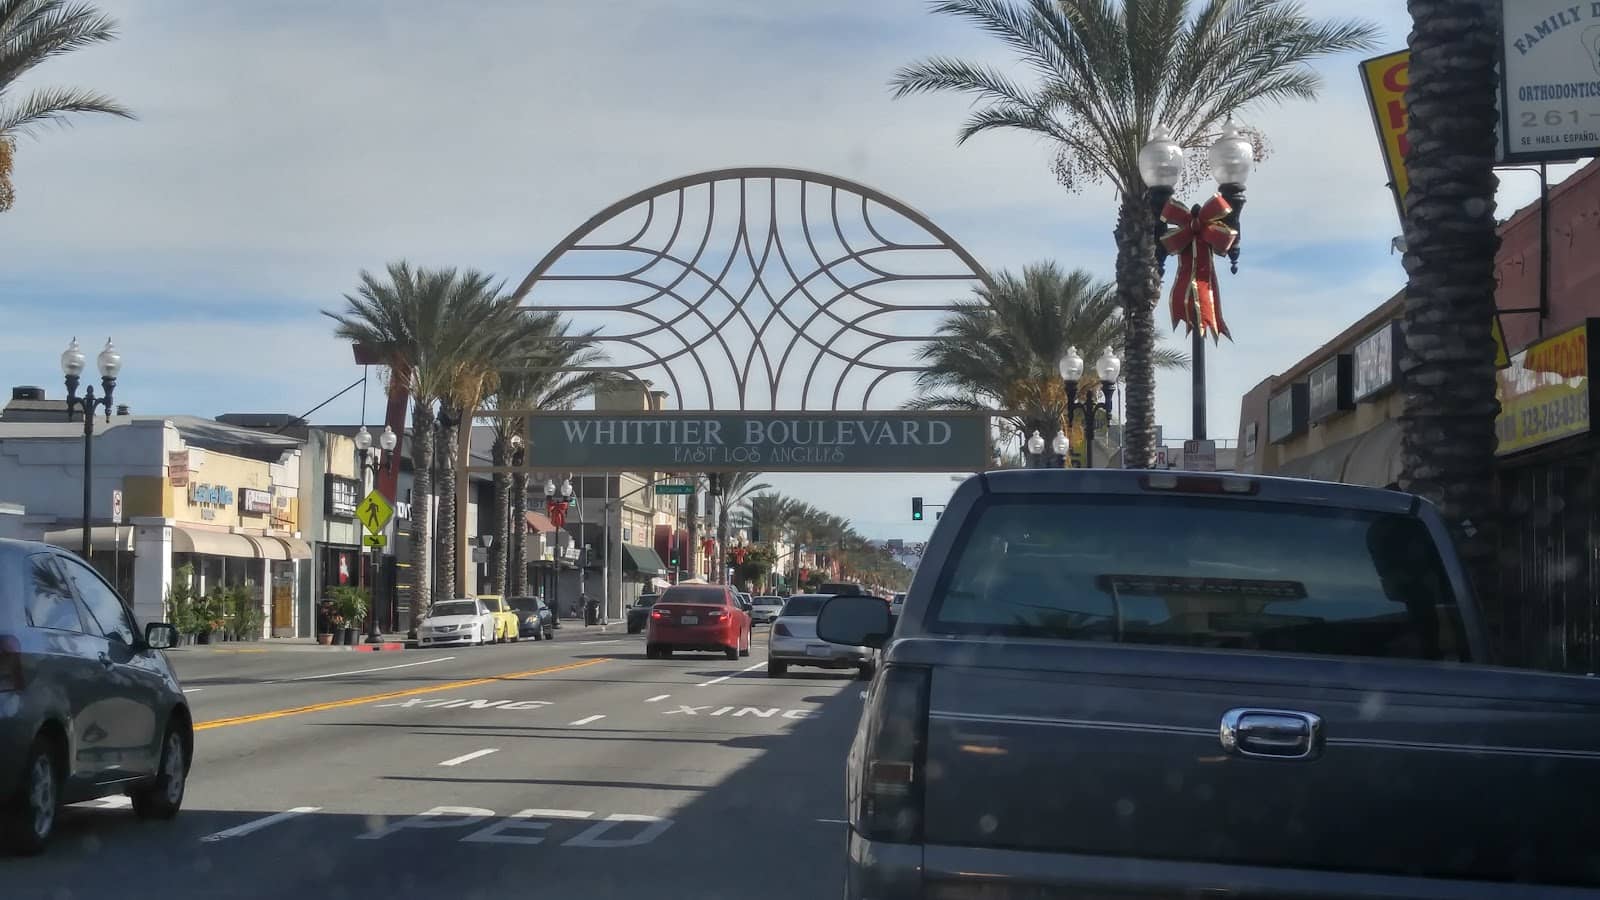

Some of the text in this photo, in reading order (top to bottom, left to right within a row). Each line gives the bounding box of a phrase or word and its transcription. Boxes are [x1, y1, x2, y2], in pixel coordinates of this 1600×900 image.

[1513, 6, 1581, 56] FAMILY
[1521, 130, 1599, 145] SE HABLA ESPAÑOL
[562, 420, 951, 445] WHITTIER BOULEVARD
[674, 446, 846, 463] EAST LOS ANGELES
[374, 698, 554, 710] XING
[353, 805, 674, 848] PED
